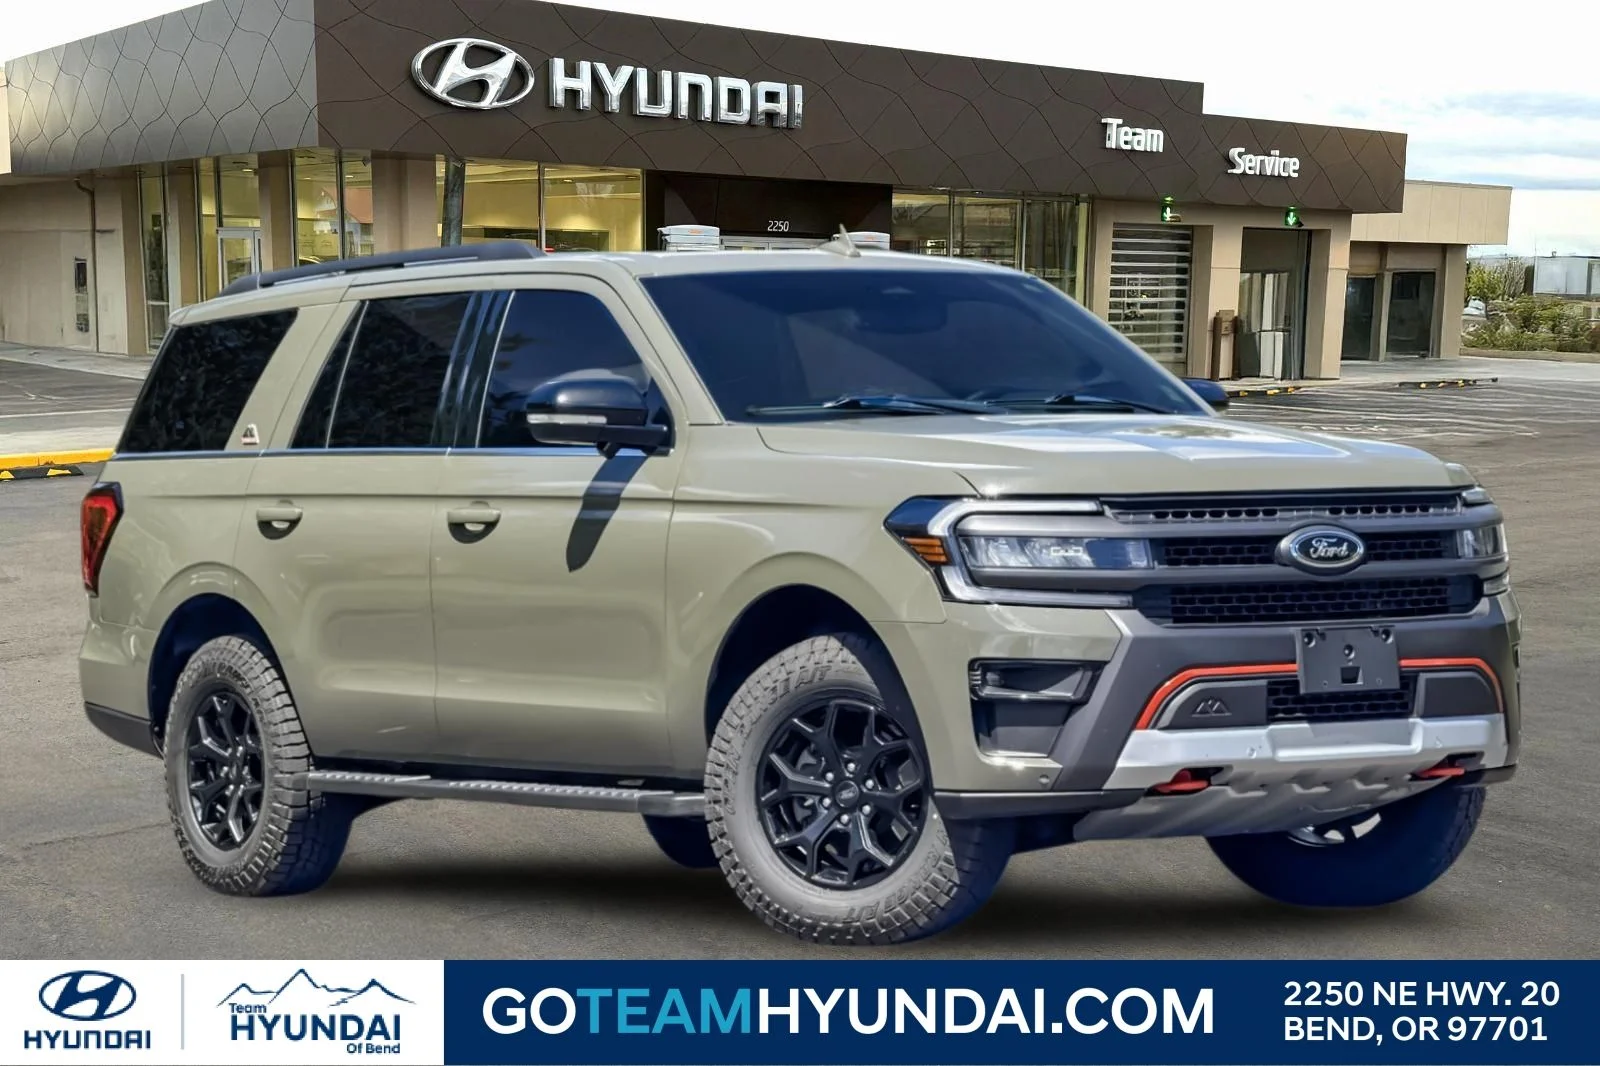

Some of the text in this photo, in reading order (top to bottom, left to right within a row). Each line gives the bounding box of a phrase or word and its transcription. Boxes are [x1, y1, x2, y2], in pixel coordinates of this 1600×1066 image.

[549, 57, 803, 129] HYUNDAI
[1101, 117, 1164, 152] Team
[1227, 147, 1300, 178] Service
[767, 220, 790, 232] 2250
[1309, 537, 1349, 559] Ford
